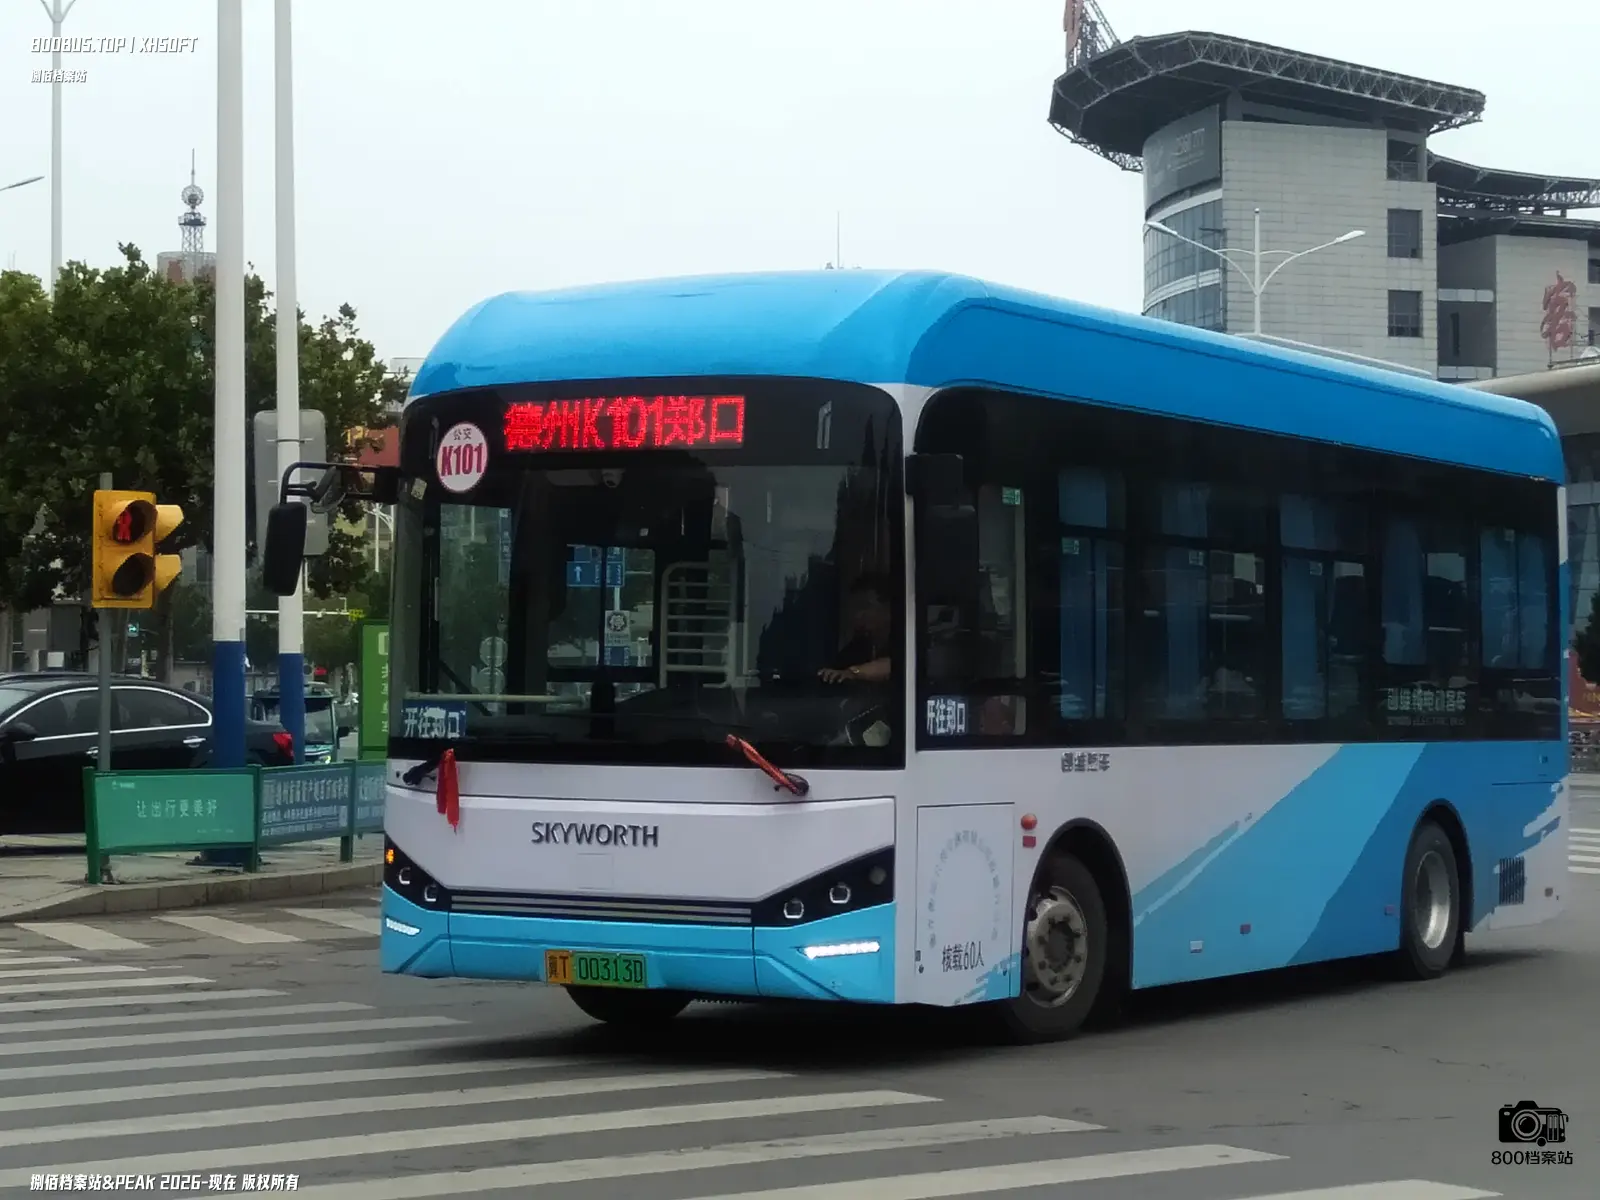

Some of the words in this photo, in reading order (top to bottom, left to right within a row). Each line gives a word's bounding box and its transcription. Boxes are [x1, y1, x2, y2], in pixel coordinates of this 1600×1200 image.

[453, 427, 472, 440] 公交
[440, 442, 484, 477] K101
[136, 799, 218, 819] 让出行更美好
[531, 821, 660, 848] SKYWORTH
[941, 941, 985, 972] 核载60人
[578, 957, 643, 983] 00313D
